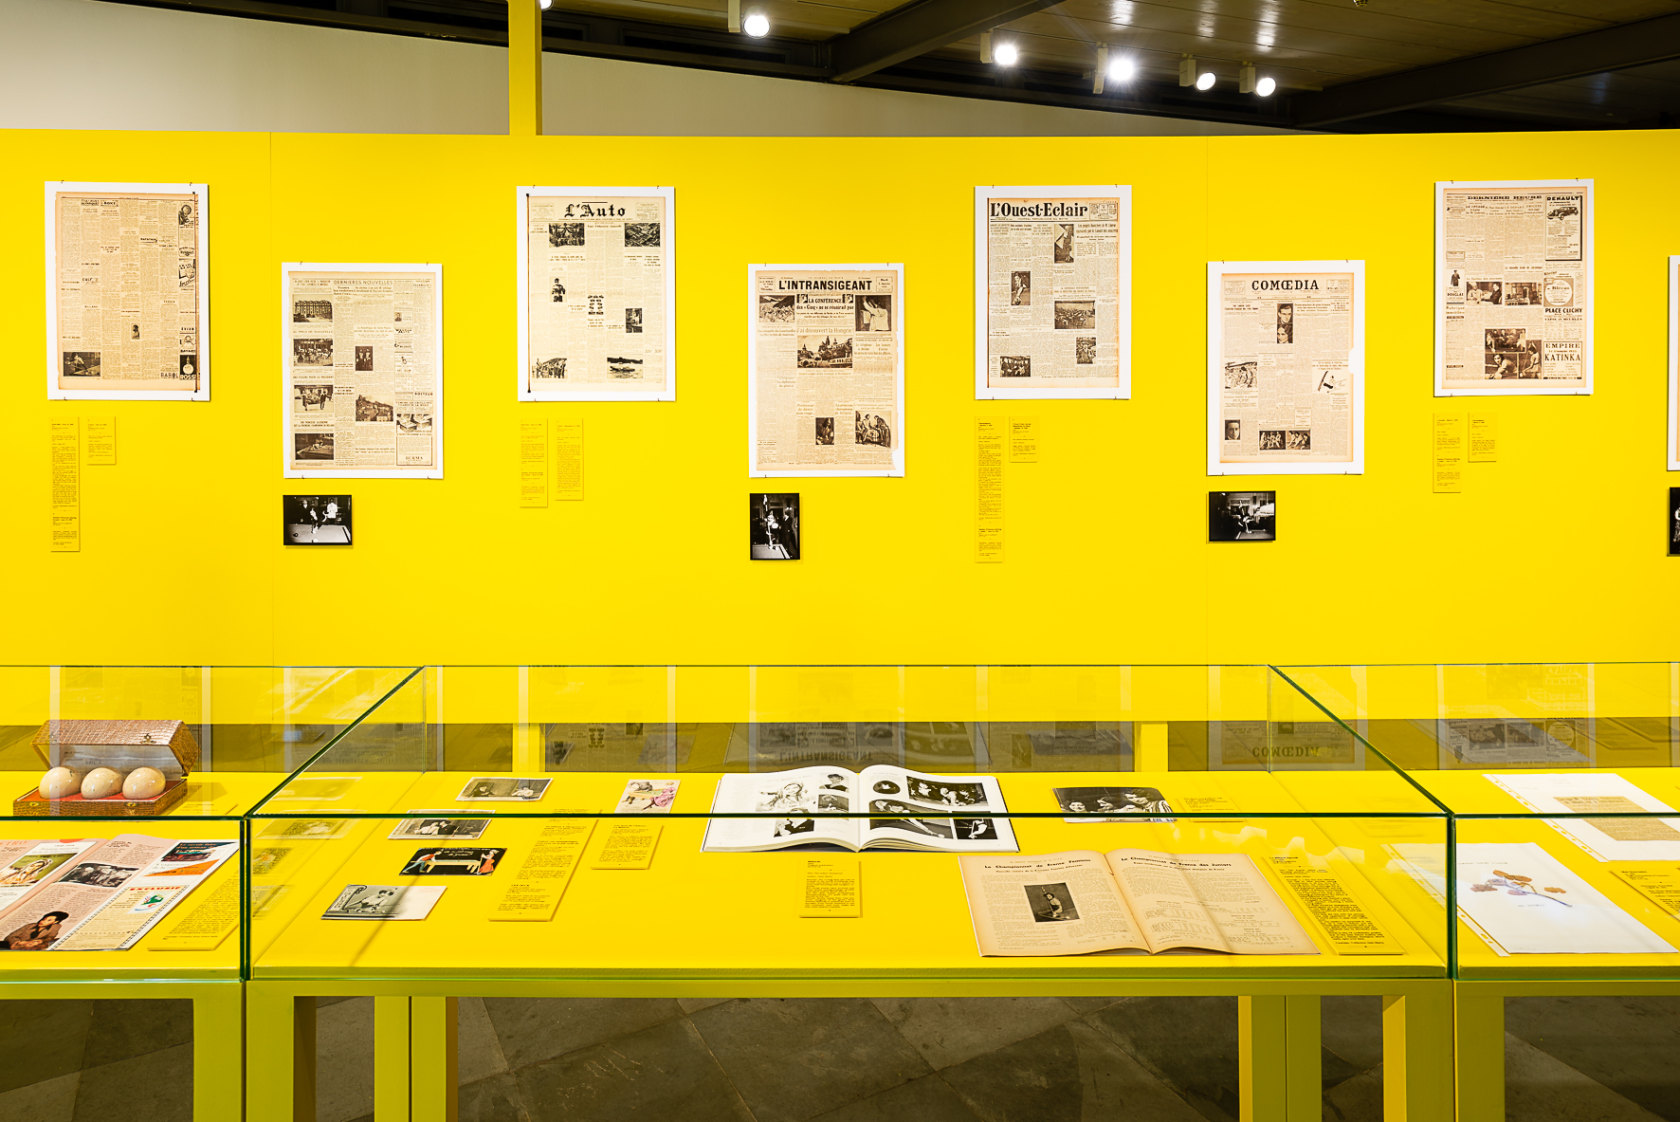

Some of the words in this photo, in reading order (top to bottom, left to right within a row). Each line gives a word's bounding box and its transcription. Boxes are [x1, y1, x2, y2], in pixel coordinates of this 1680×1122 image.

[564, 203, 626, 218] L'Auto
[990, 202, 1088, 217] L'Ouest-Eclair
[778, 280, 873, 291] L'INTRANSIGEANT
[1251, 279, 1320, 291] COMŒDIA
[1544, 353, 1581, 361] KATINKA
